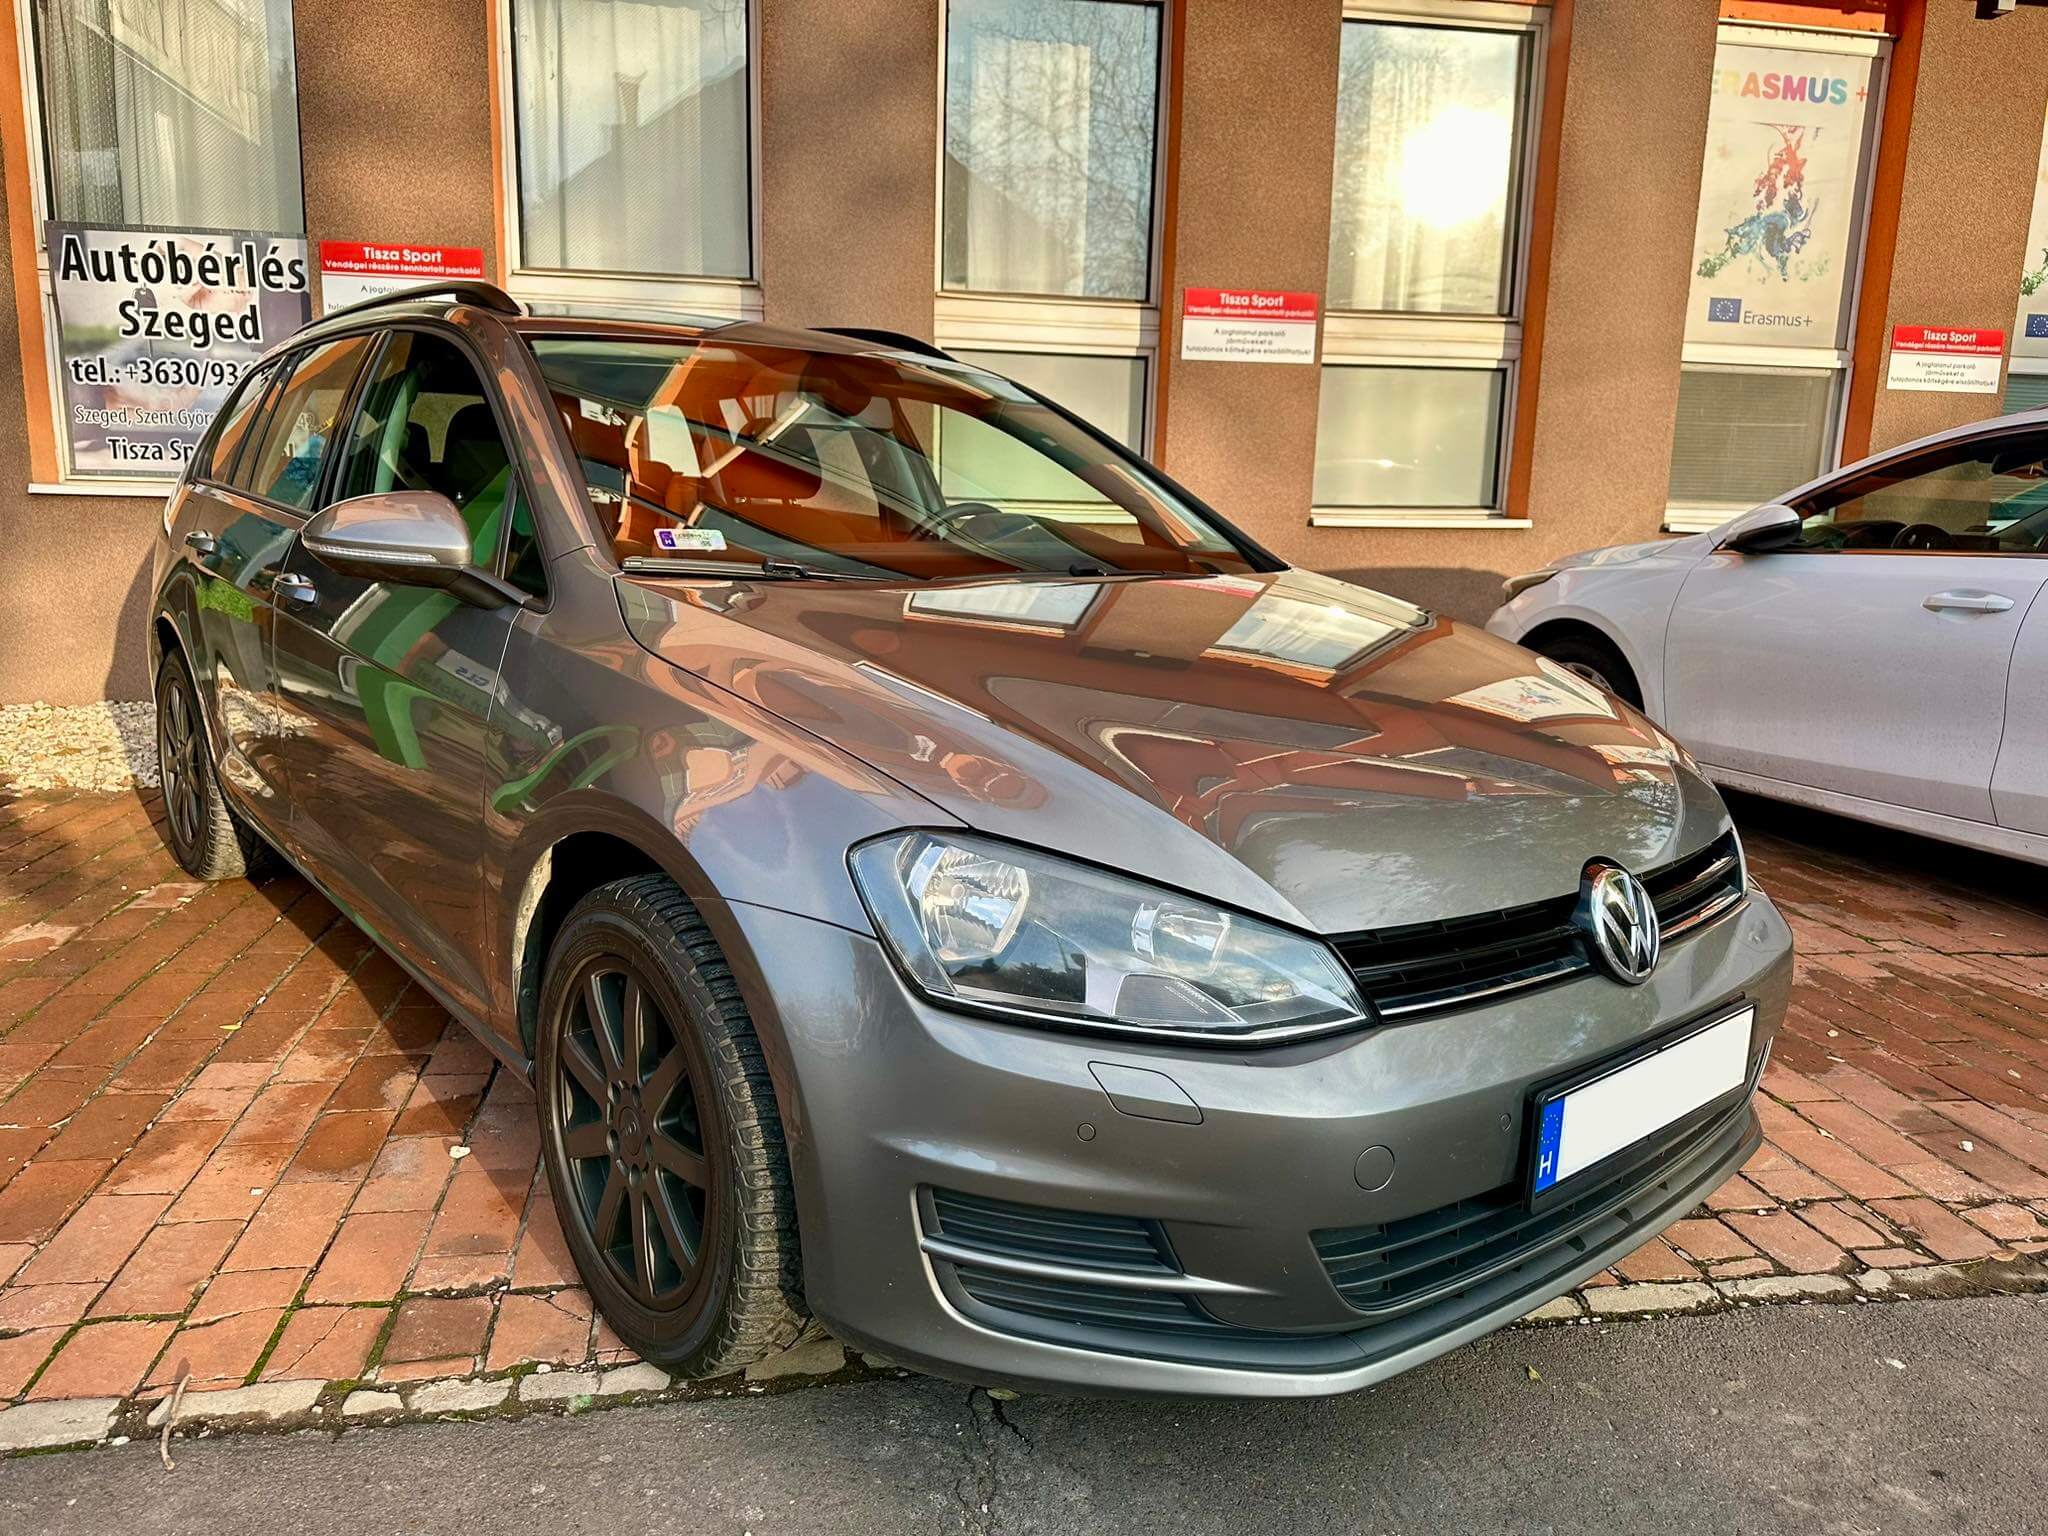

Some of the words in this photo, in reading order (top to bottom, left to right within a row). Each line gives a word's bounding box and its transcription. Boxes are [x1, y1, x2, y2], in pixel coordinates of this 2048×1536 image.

[61, 237, 306, 291] Autóbérlés
[363, 246, 400, 260] Tisza
[402, 248, 442, 263] Sport
[360, 284, 368, 293] A
[1219, 292, 1249, 306] Tisza
[1251, 294, 1284, 308] Sport
[118, 300, 260, 348] Szeged
[1743, 310, 1813, 327] Erasmus+
[1923, 329, 1948, 341] Tisza
[1949, 331, 1977, 344] Sport
[75, 406, 132, 427] Szeged,
[135, 407, 174, 425] Szent
[178, 408, 214, 430] Györ
[107, 438, 164, 461] Tisza
[1538, 1150, 1553, 1179] H
